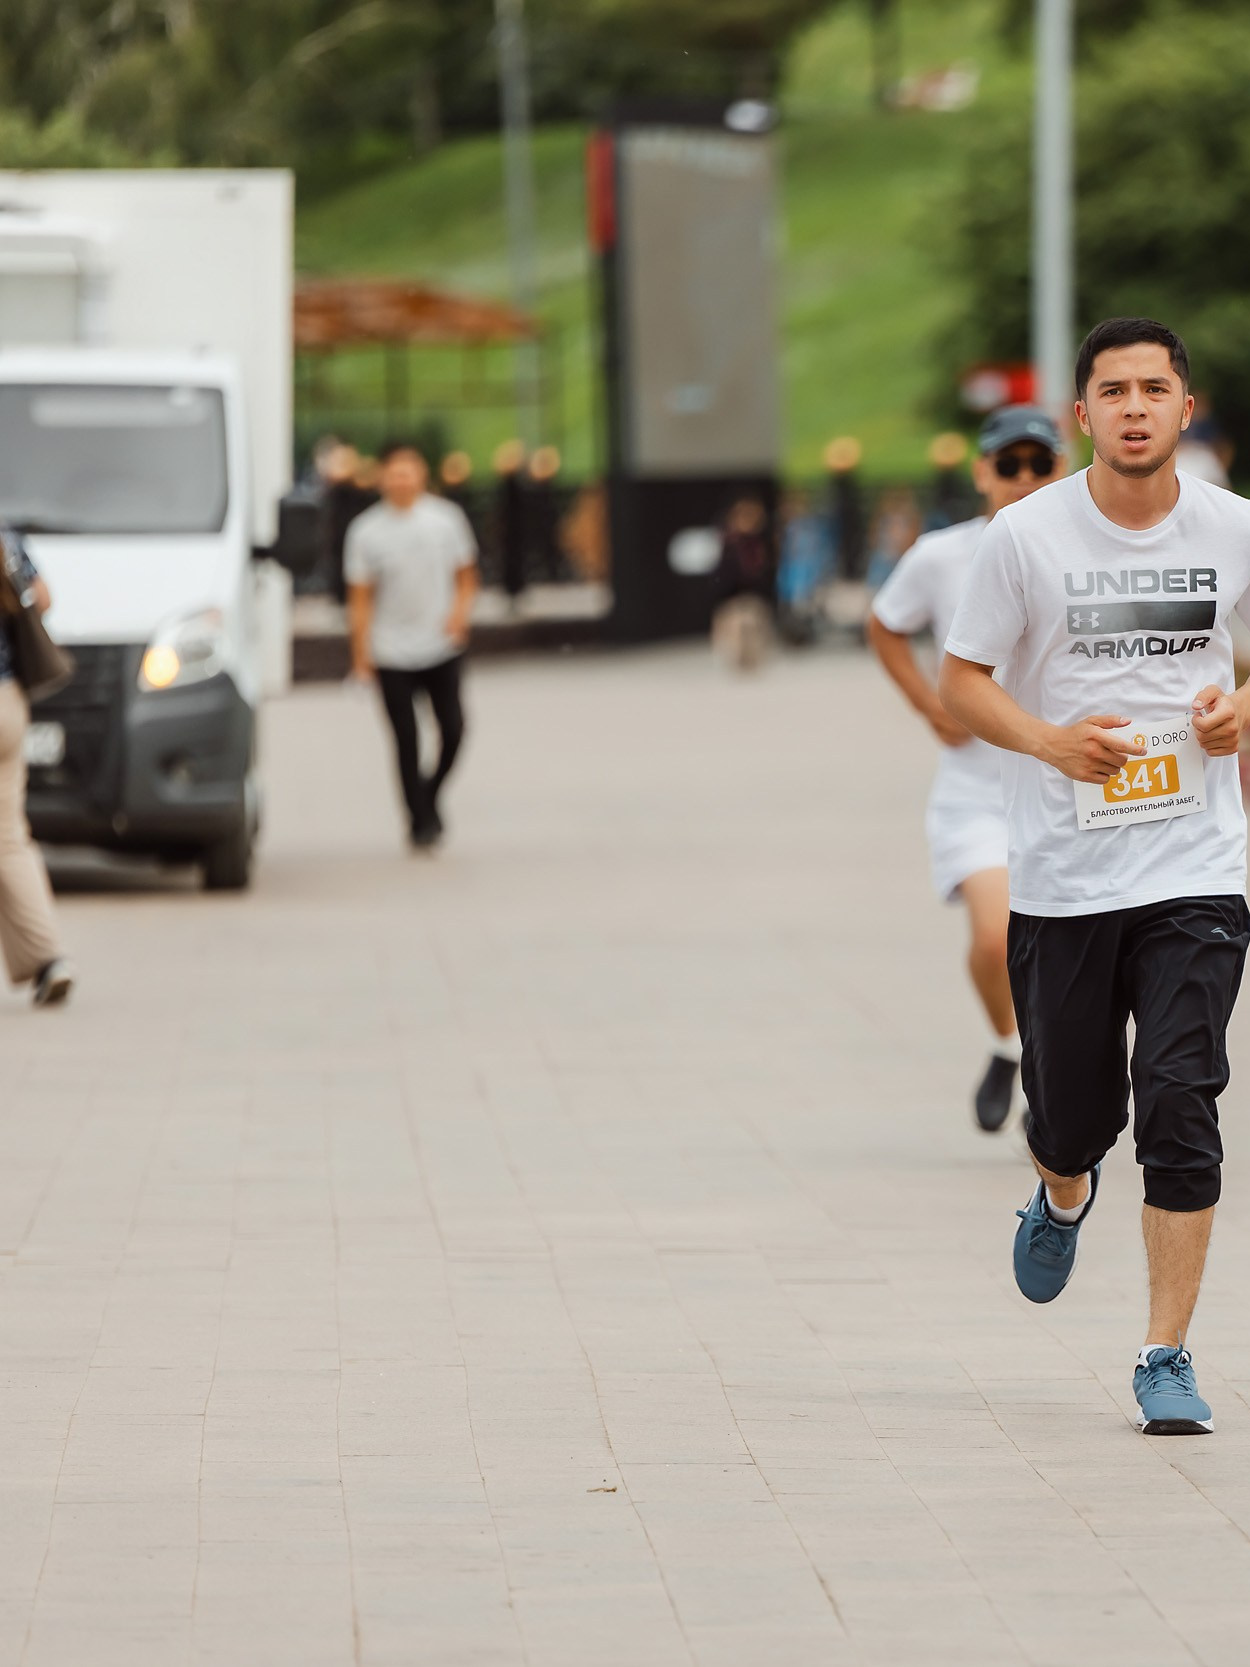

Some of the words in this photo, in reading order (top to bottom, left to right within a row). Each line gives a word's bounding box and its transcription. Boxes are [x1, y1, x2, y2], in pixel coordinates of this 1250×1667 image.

[1064, 568, 1218, 597] UNDER
[1068, 636, 1211, 659] ARMOUR
[1151, 730, 1188, 746] D'ORO
[1110, 761, 1169, 797] 341
[1090, 799, 1175, 818] БЛАГОТВОРИТЕЛЬНЫЙ
[1175, 795, 1195, 806] ЗАБЕГ
